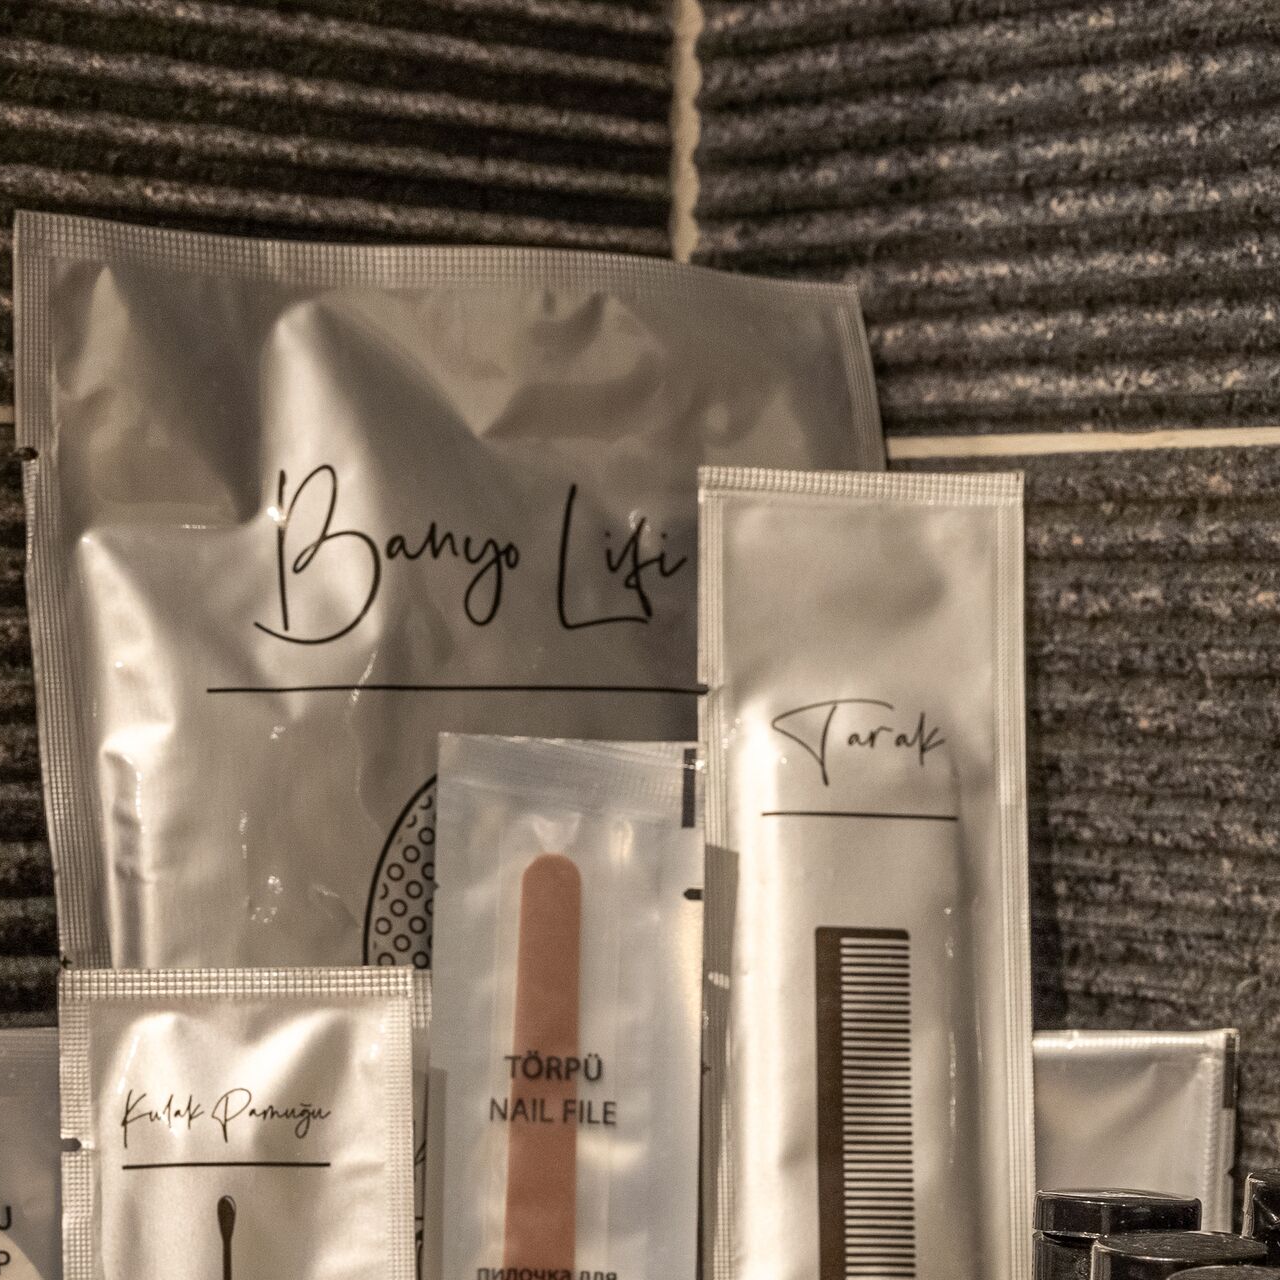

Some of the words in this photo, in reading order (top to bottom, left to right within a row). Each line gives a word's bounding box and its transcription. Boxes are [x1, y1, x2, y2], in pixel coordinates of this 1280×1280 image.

[253, 464, 520, 644] Banyo
[557, 483, 688, 630] Lifi
[772, 699, 947, 786] Tarak
[504, 1051, 603, 1082] TÖRPÜ
[120, 1088, 204, 1149] Kulak
[211, 1087, 331, 1143] Pamuğu
[489, 1097, 554, 1123] NAIL
[562, 1100, 617, 1126] FILE
